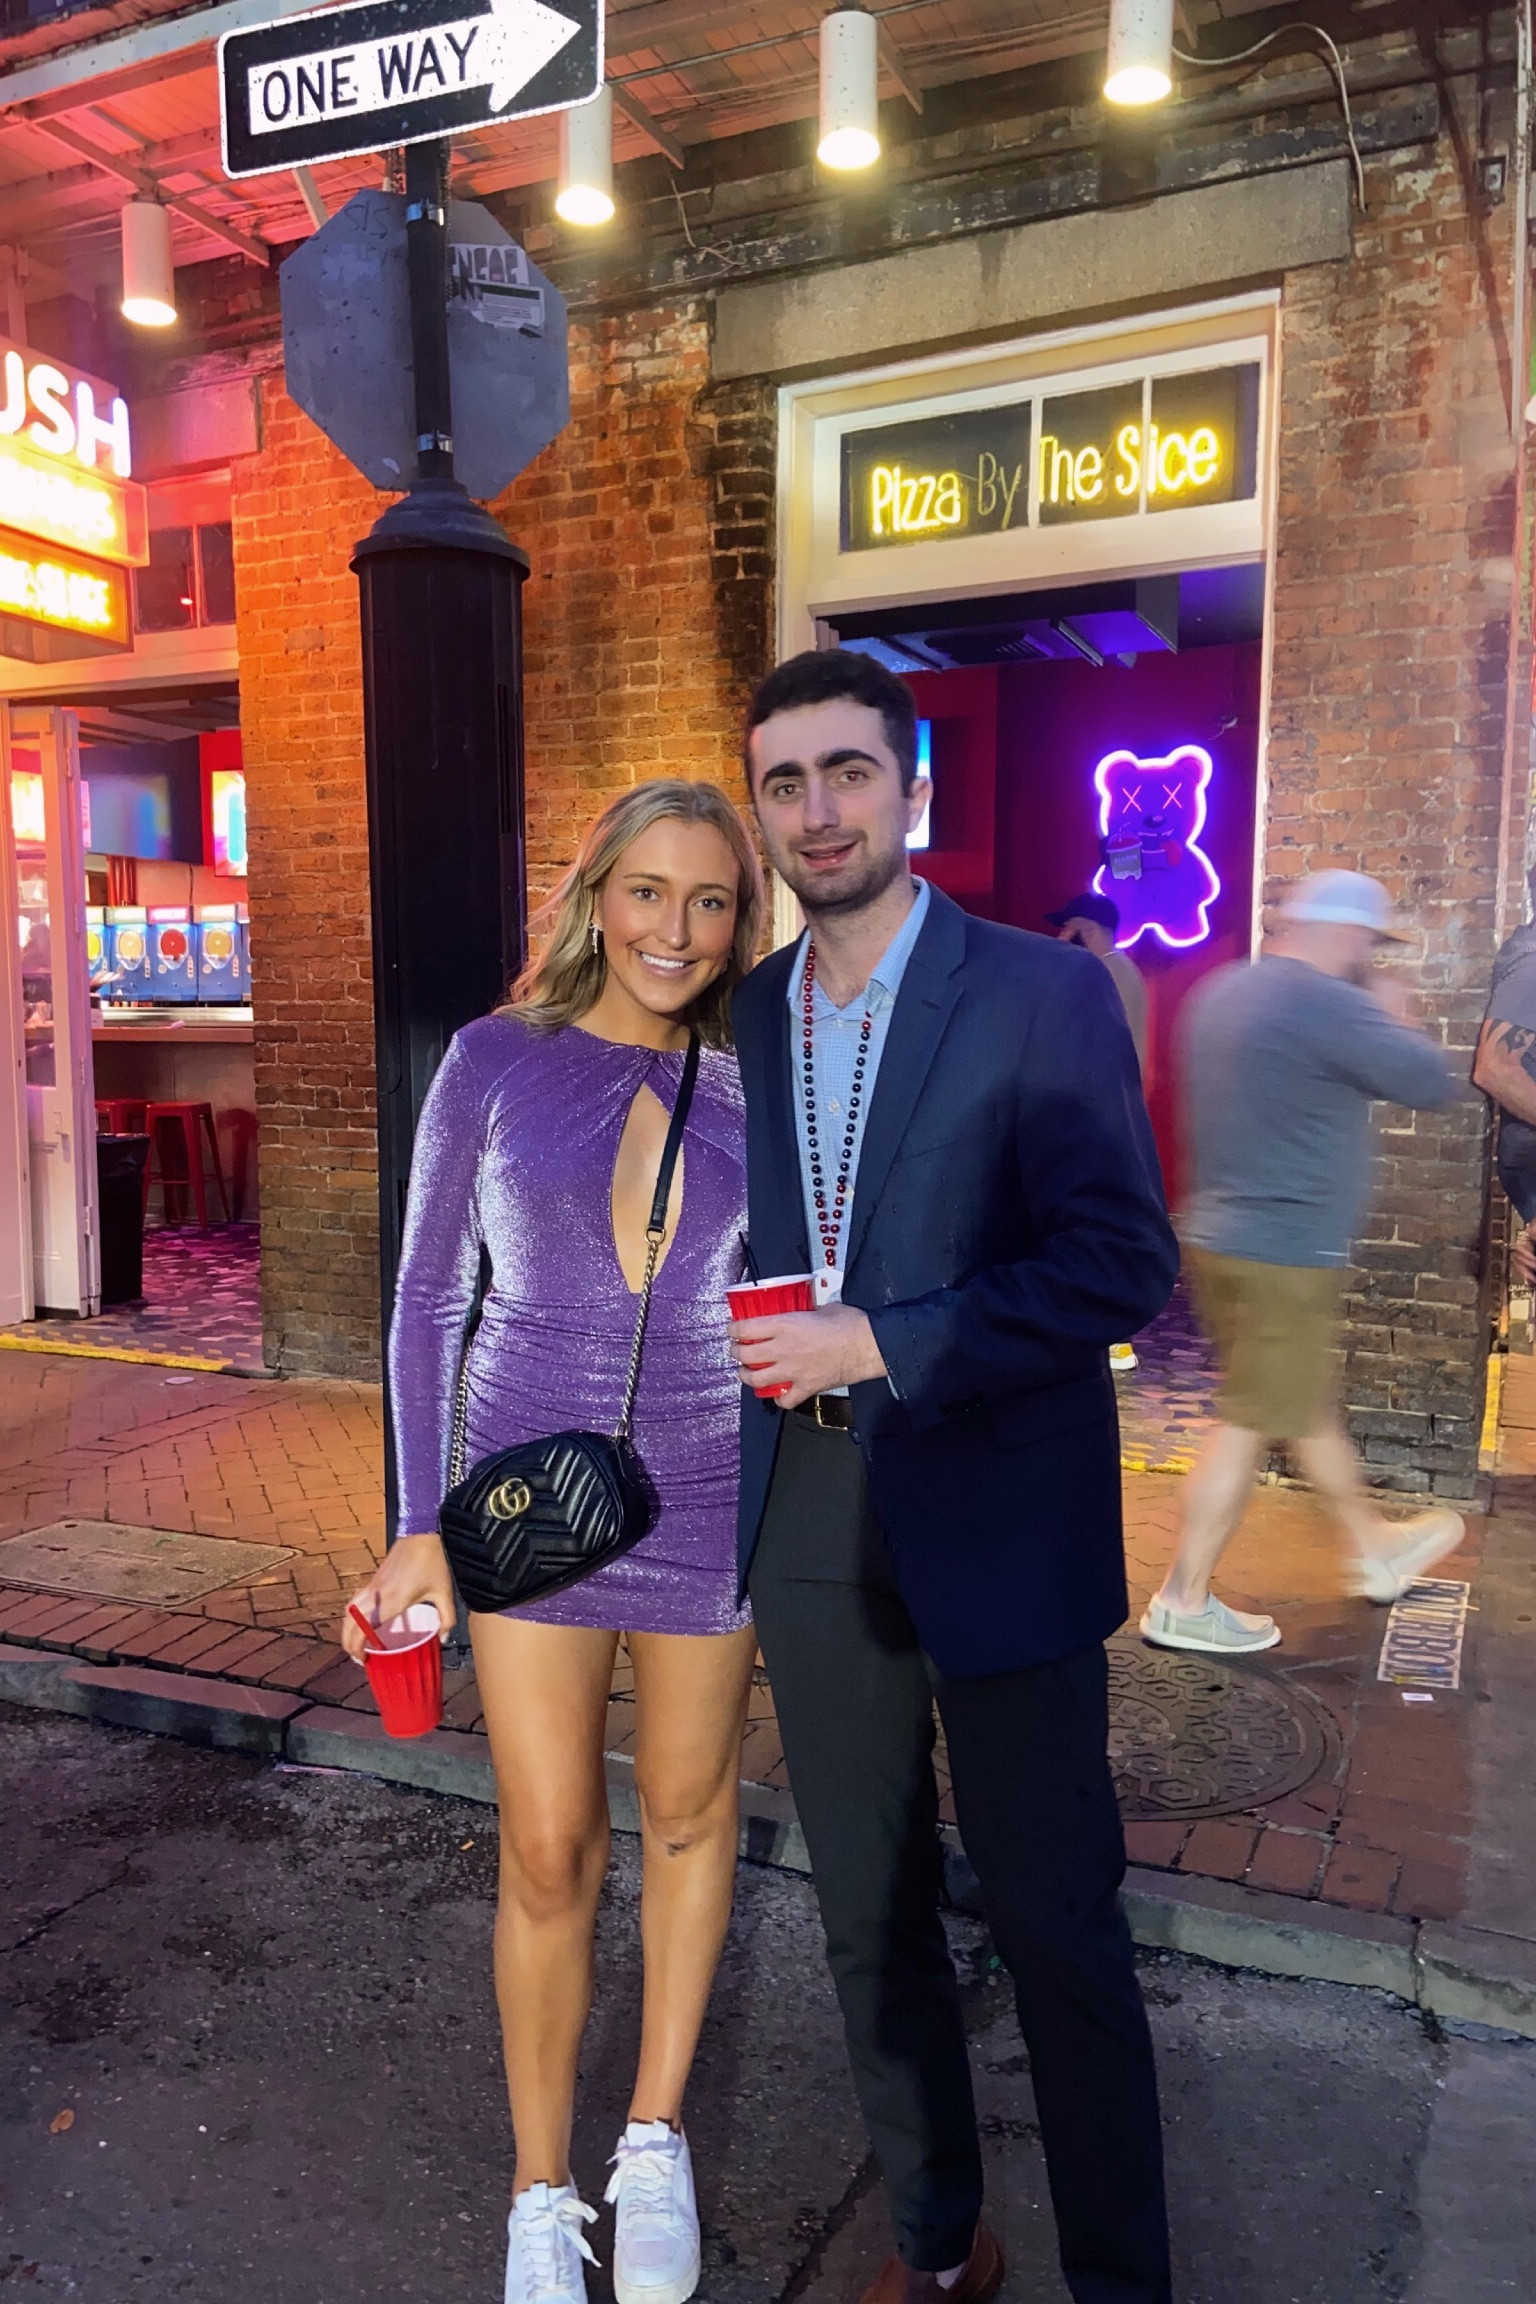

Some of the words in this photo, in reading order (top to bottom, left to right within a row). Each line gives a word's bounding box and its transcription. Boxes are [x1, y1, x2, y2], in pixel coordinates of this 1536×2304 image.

[263, 55, 358, 122] ONE
[377, 25, 480, 100] WAY
[872, 465, 962, 534] Pizza
[978, 451, 1023, 530] By
[1039, 435, 1103, 503] The
[1115, 423, 1217, 496] Sice
